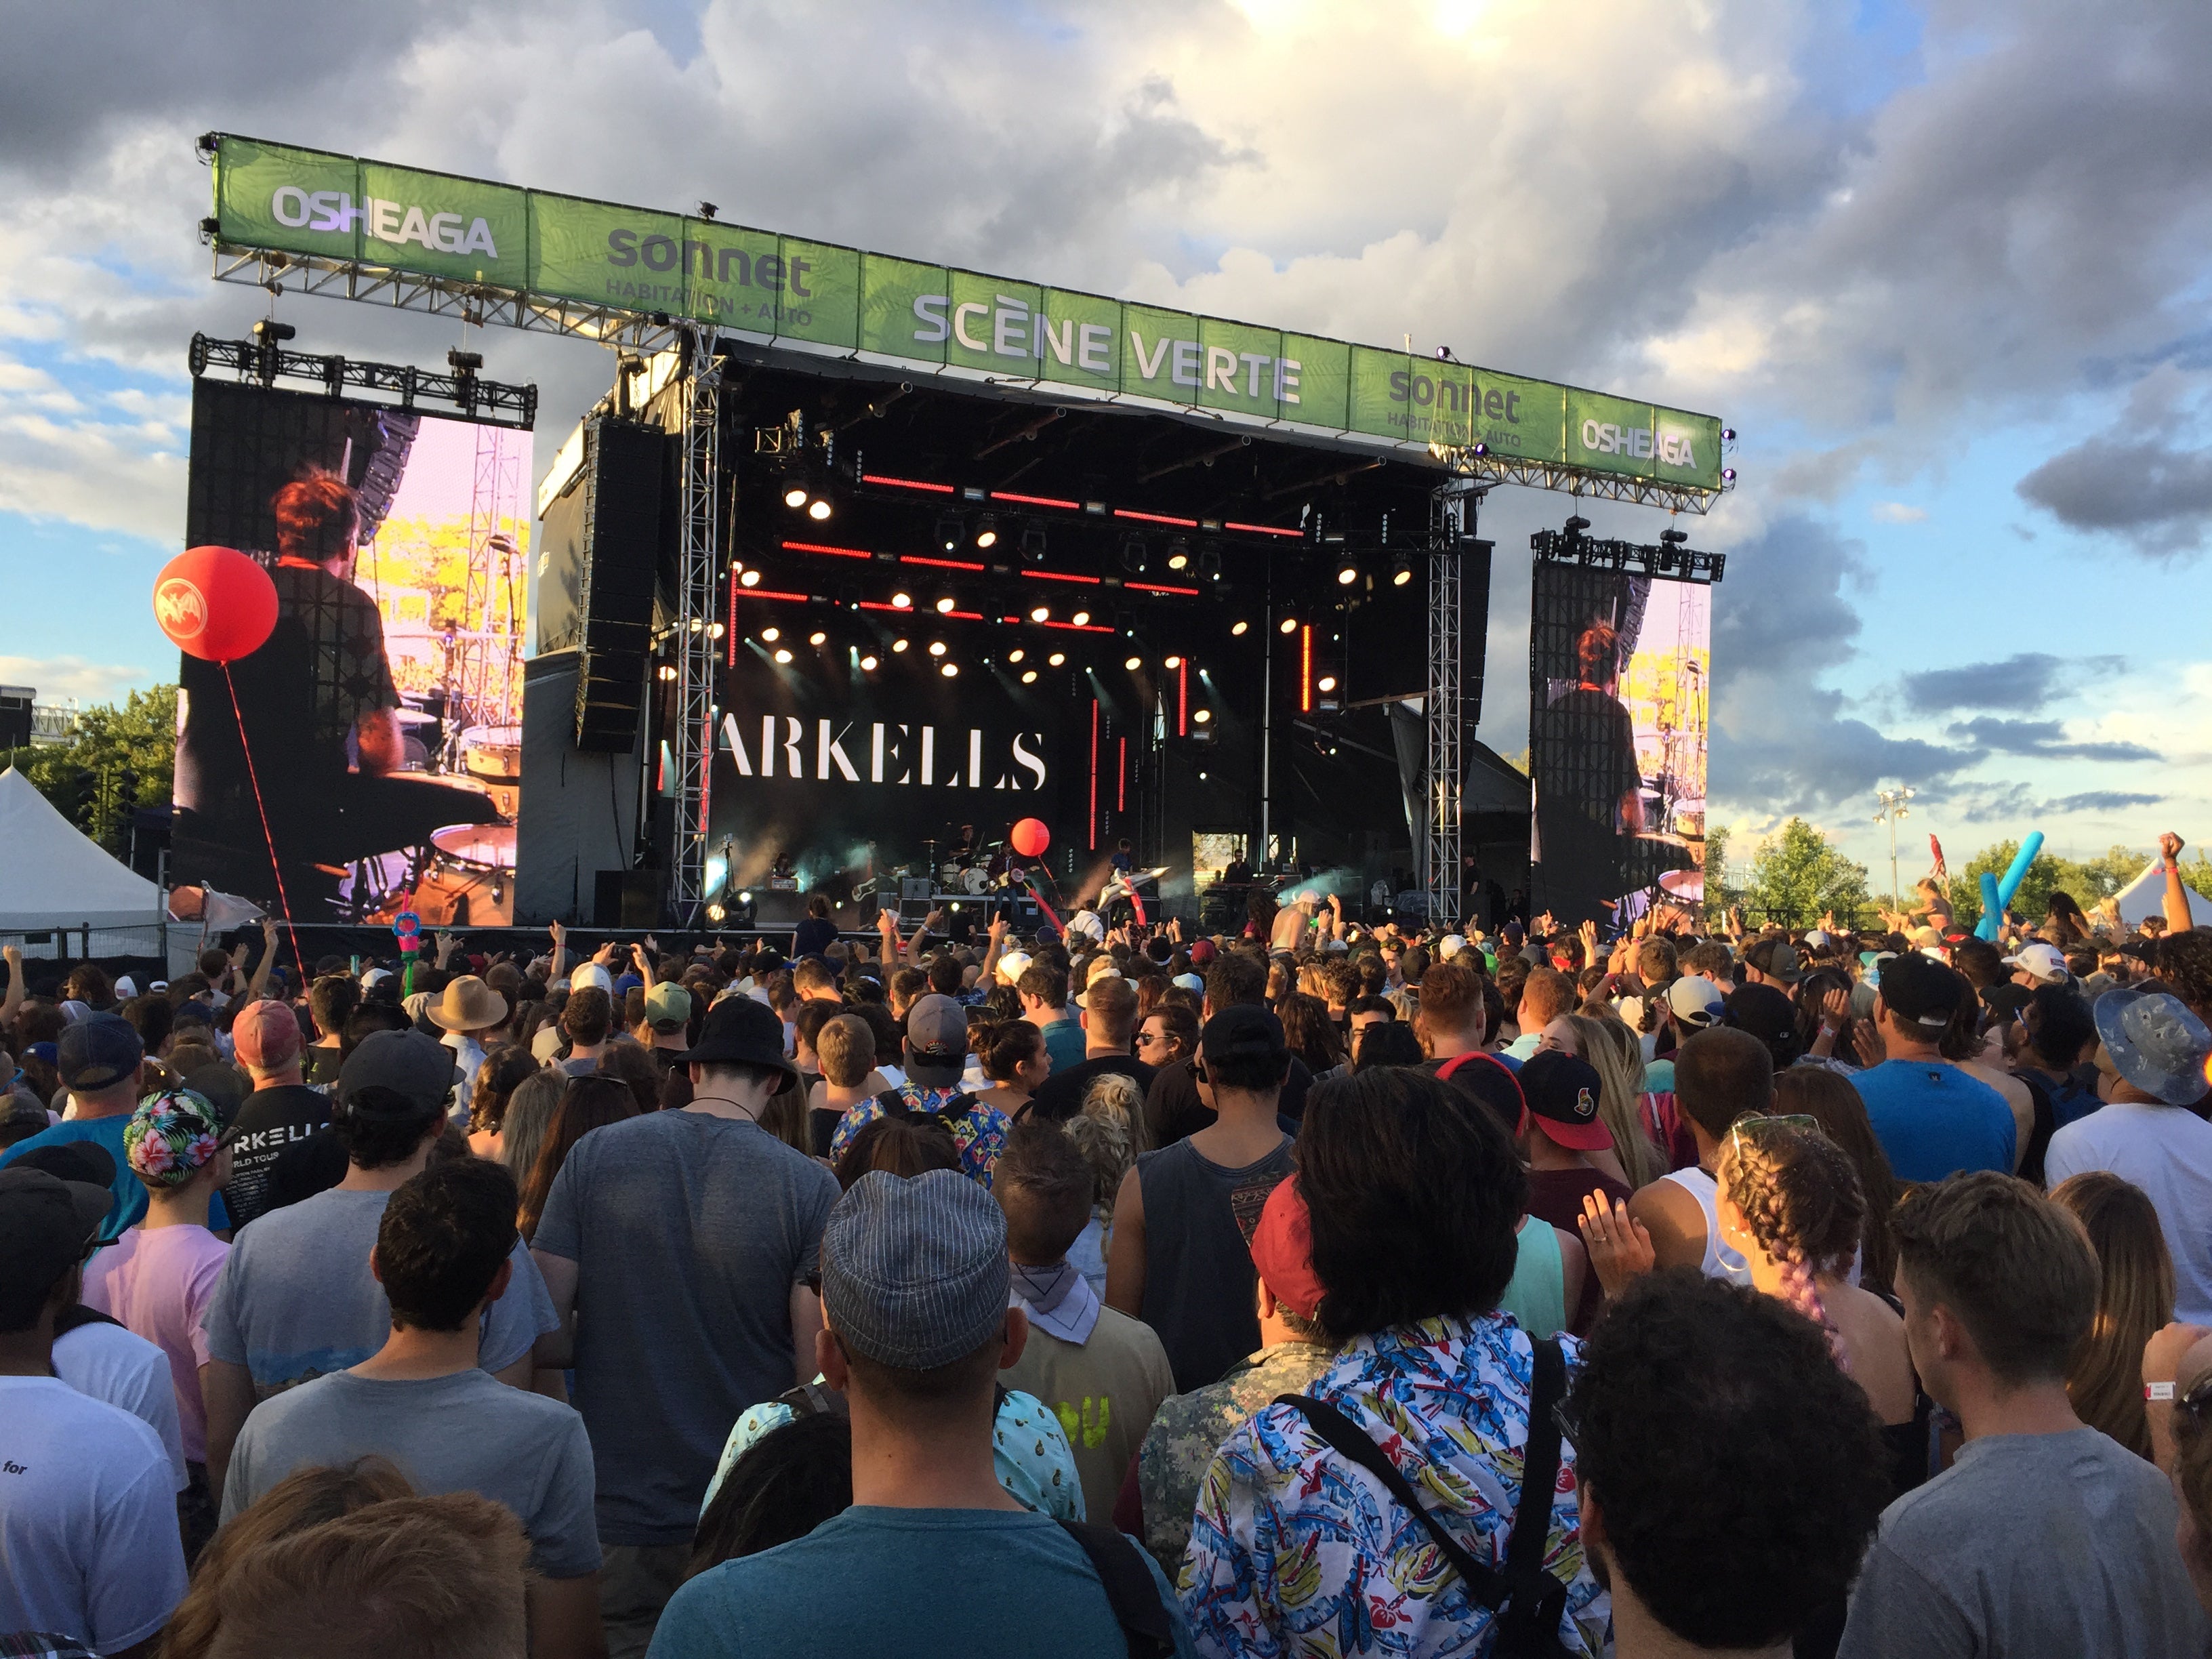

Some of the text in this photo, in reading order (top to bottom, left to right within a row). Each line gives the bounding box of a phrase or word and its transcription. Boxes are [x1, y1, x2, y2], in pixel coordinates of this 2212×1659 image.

[272, 185, 498, 259] OSHEAGA
[607, 228, 811, 298] sonnet
[606, 278, 734, 314] HABITATION
[758, 302, 813, 327] AUTO
[913, 294, 1301, 404] SCÈNE VERTE
[1389, 371, 1521, 424] sonnet
[1387, 411, 1471, 437] HABITATION
[1486, 429, 1521, 447] AUTO
[1582, 419, 1697, 469] OSHEAGA
[715, 712, 1046, 791] ARKELLS
[234, 1122, 330, 1153] RKELL
[233, 1158, 252, 1168] RLD
[3, 1460, 28, 1475] for
